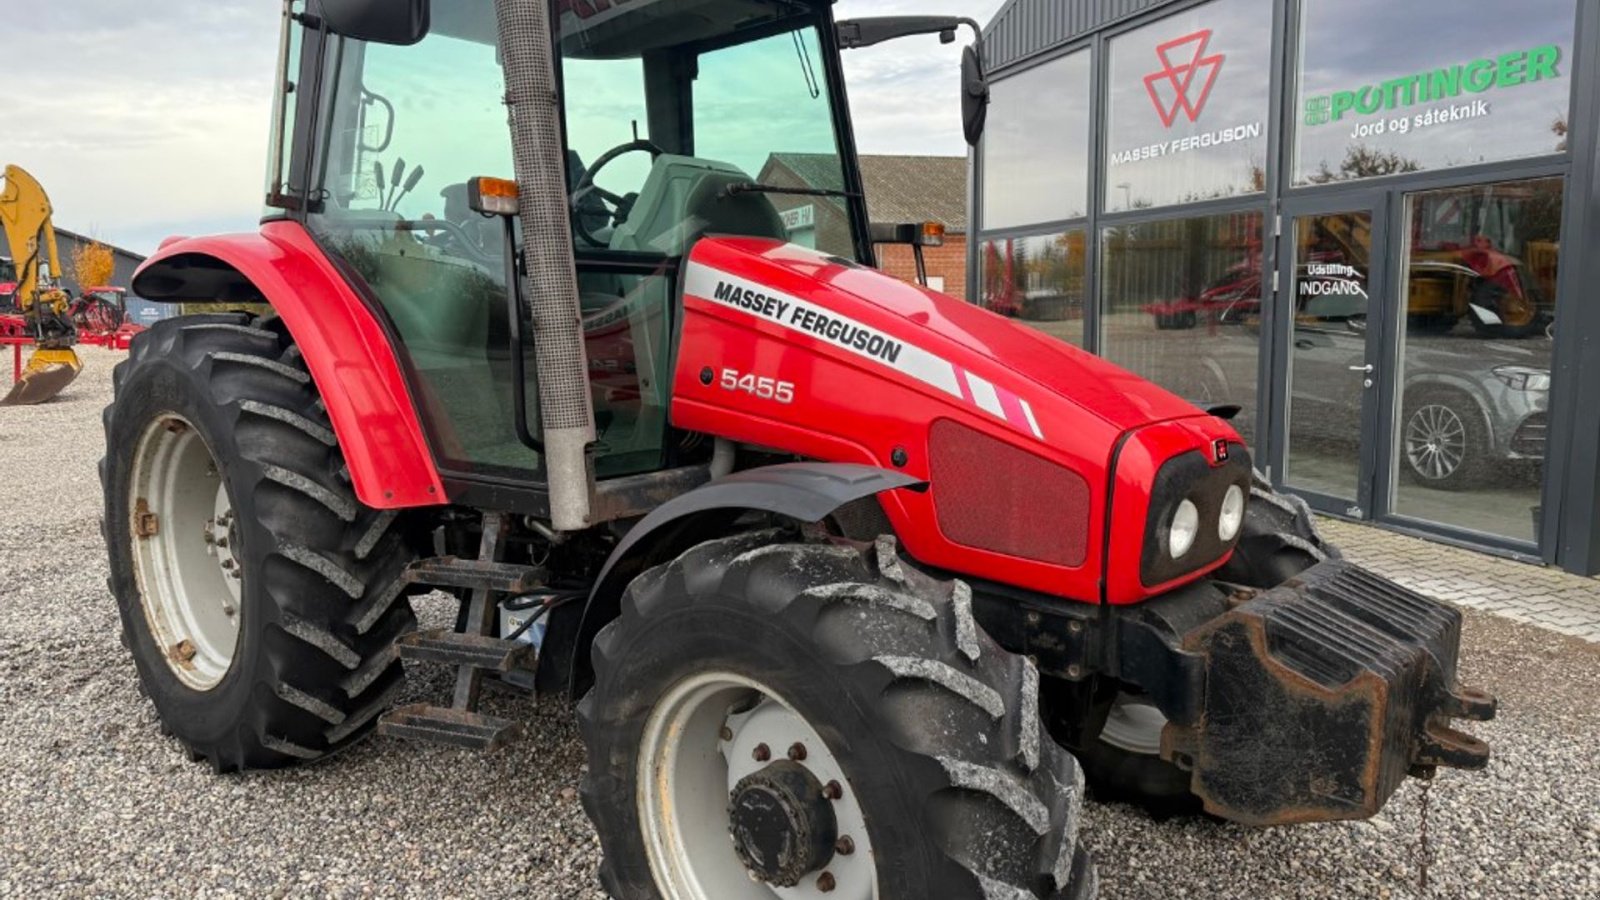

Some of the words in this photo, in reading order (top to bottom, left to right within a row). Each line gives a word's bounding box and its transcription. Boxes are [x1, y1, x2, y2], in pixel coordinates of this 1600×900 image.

[1351, 120, 1384, 139] Jord
[1389, 116, 1409, 133] og
[1414, 101, 1488, 126] såteknik
[1110, 142, 1169, 167] MASSEY
[1171, 122, 1260, 153] FERGUSON
[1300, 281, 1361, 295] INDGANG
[1307, 264, 1353, 276] Udstilling
[713, 281, 790, 320] MASSEY
[790, 306, 902, 363] FERGUSON
[720, 368, 795, 404] 5455
